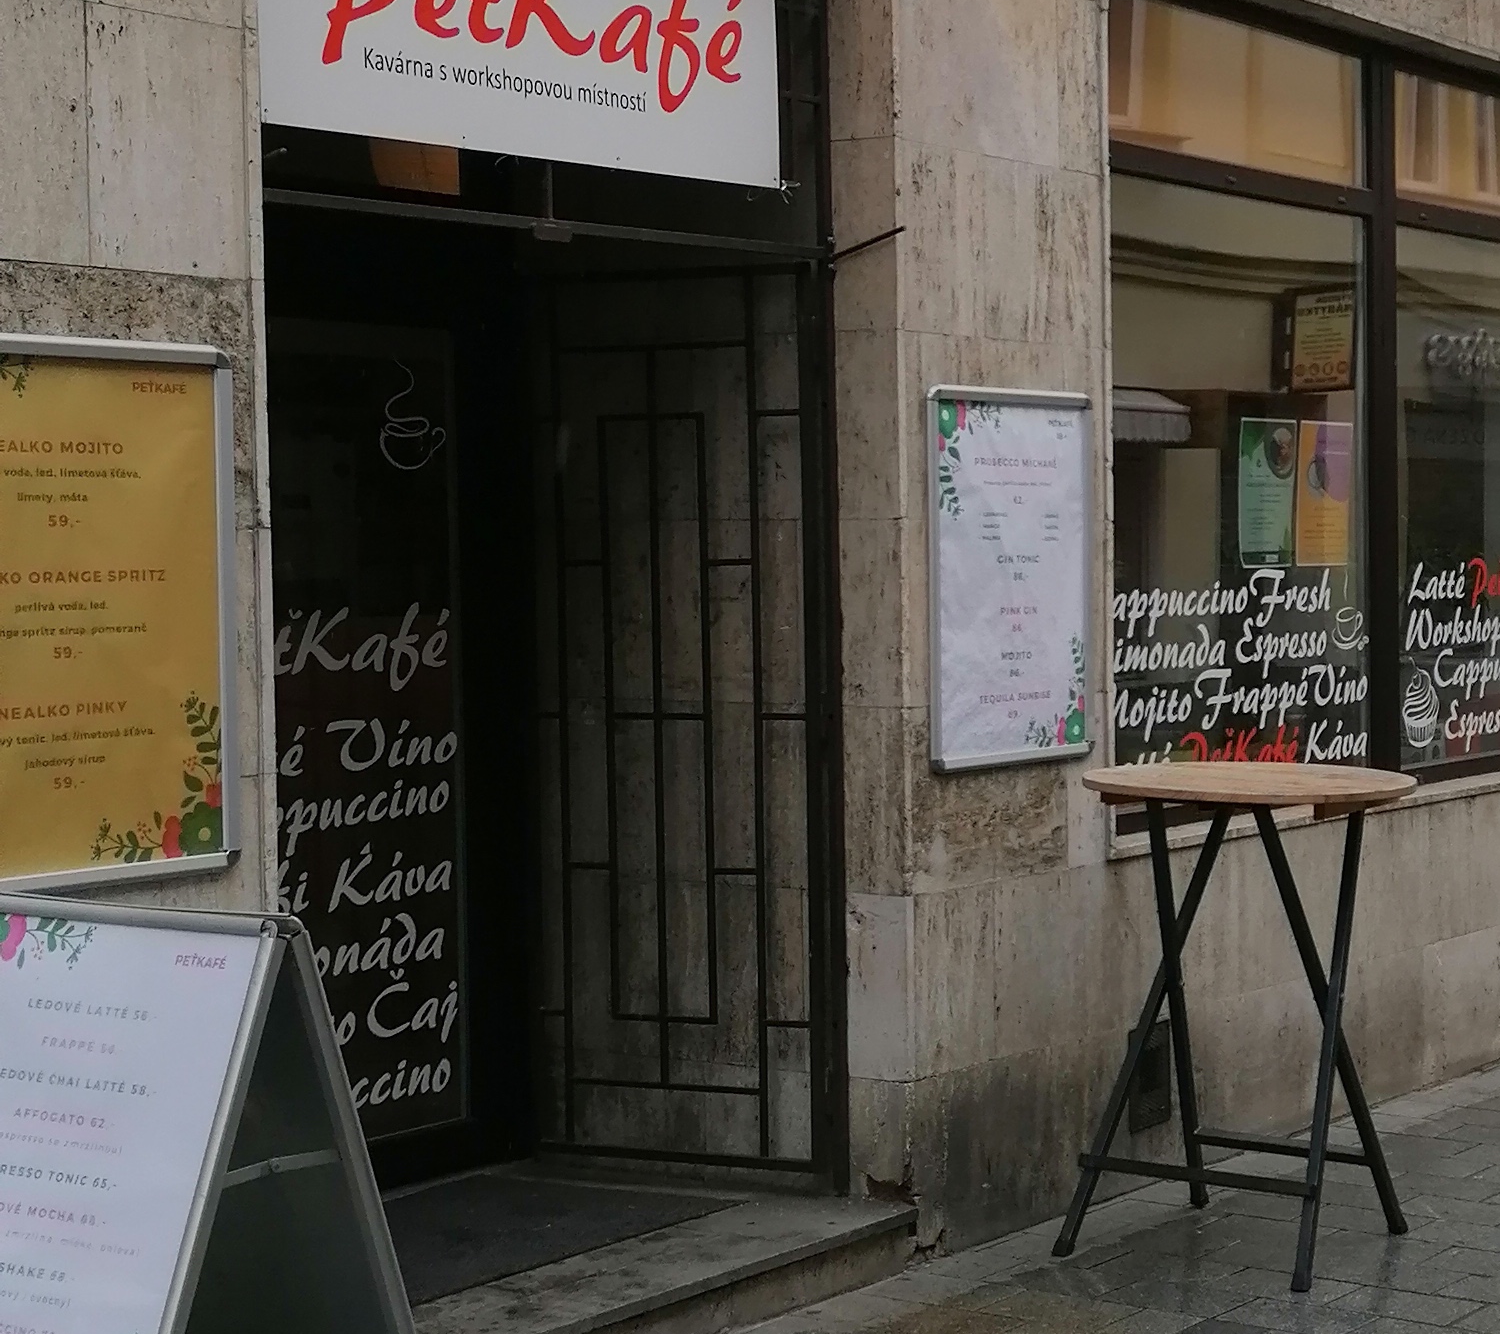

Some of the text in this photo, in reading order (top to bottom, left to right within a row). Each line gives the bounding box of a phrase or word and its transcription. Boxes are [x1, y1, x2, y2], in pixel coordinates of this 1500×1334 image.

[363, 46, 647, 112] Kavárna s workshopovou místností
[60, 441, 124, 455] MOJITO
[974, 457, 1020, 467] PROSECCO
[28, 571, 102, 584] ORANGE
[107, 569, 165, 583] SPRITZ
[1407, 561, 1466, 607] Latté
[1250, 567, 1332, 628] Fresh
[1235, 618, 1328, 679] Espresso
[1194, 667, 1308, 730] Frappé
[1306, 663, 1368, 707] Víno
[76, 700, 128, 716] PINKY
[326, 718, 458, 771] Víno
[1305, 718, 1368, 764] Káva
[24, 755, 76, 770] jahodový
[175, 953, 227, 970] PEŤKAFÉ
[28, 998, 82, 1014] LEDOVÉ
[87, 1005, 129, 1019] LATTÉ
[367, 968, 458, 1043] Čaj
[49, 1073, 81, 1087] CHAI
[84, 1078, 125, 1094] LATTÉ
[13, 1107, 85, 1127] AFFOGATO
[48, 1170, 88, 1186] TONIC
[27, 1206, 75, 1223] MOCHA
